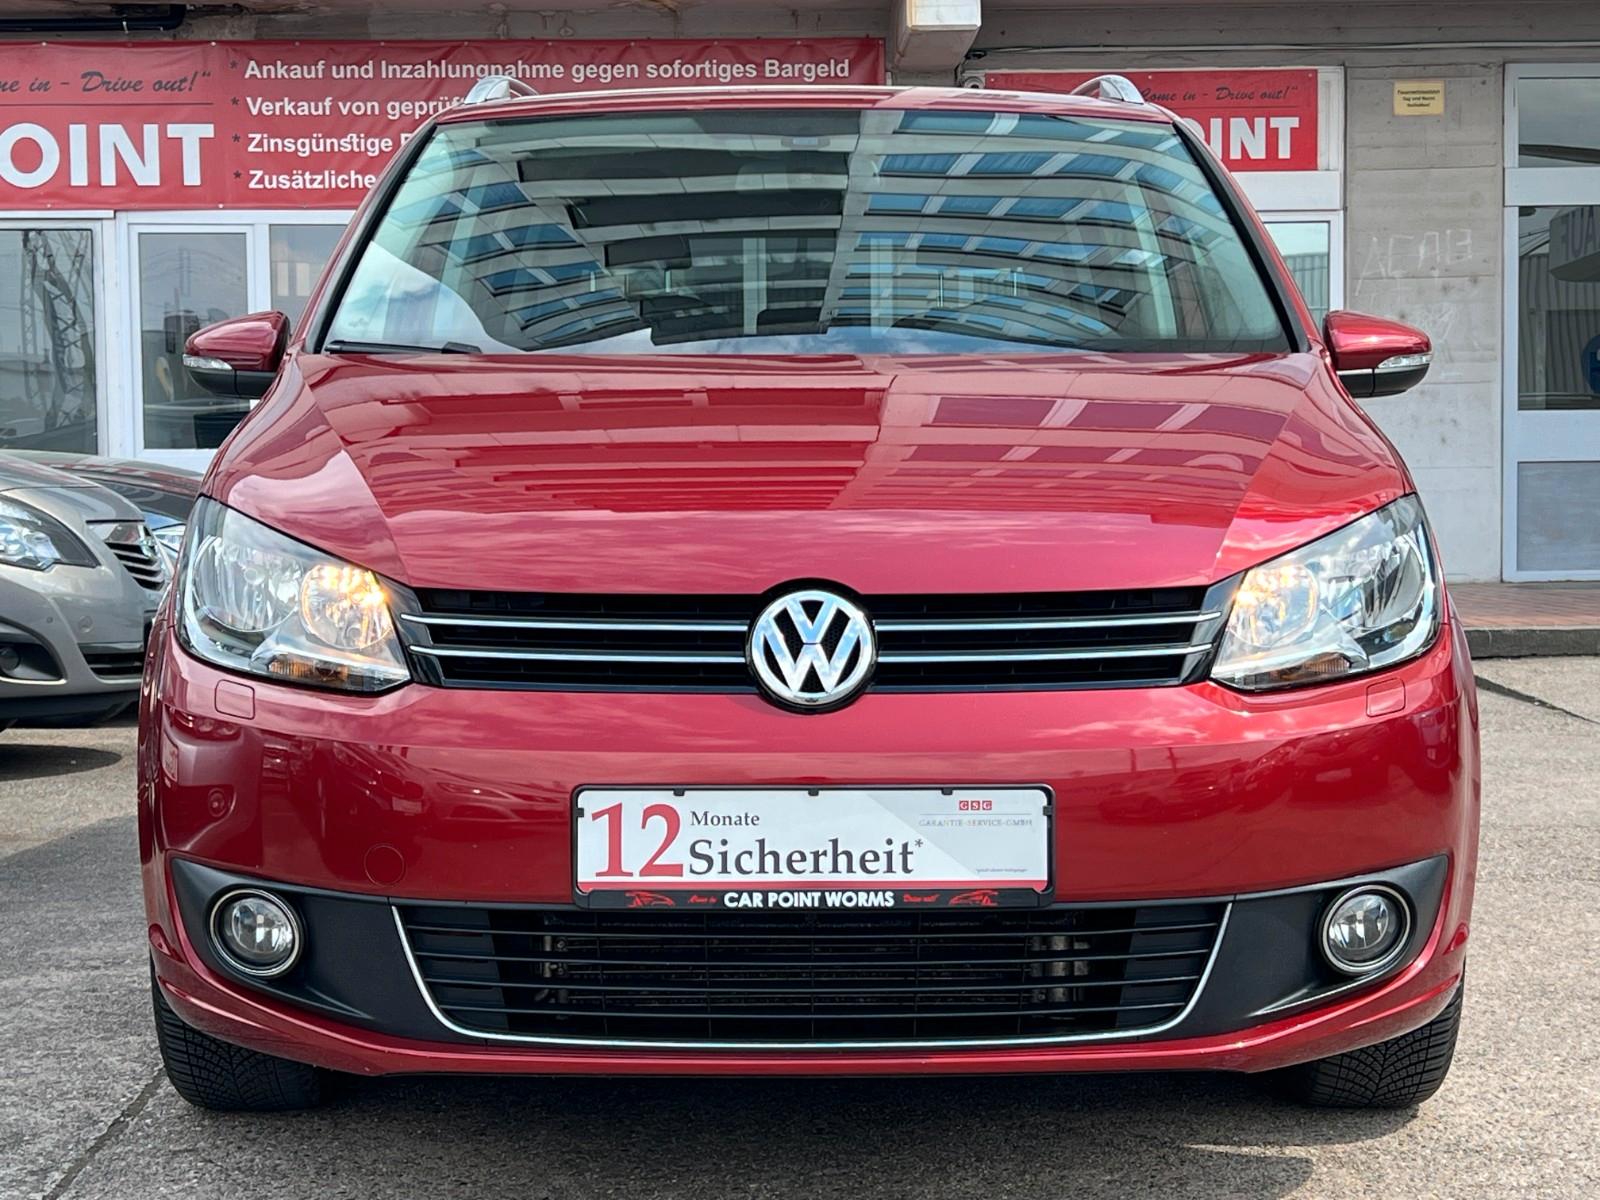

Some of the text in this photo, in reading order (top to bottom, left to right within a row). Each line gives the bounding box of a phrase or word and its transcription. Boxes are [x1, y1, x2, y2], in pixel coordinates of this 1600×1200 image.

[29, 77, 51, 92] in
[80, 71, 143, 92] Drive
[244, 59, 849, 83] Ankauf und Inzahlungnahme gegen sofortiges Bargeld
[1183, 91, 1196, 101] in
[1216, 86, 1254, 101] Drive
[246, 97, 332, 116] Verkauf
[338, 101, 379, 116] von
[247, 132, 393, 157] Zinsgünstige
[248, 169, 377, 190] Zusätzliche
[752, 590, 872, 704] VW
[959, 800, 992, 811] GSG
[690, 810, 760, 827] Monate
[591, 802, 684, 878] 12
[723, 891, 763, 908] CAR
[768, 891, 822, 908] POINT
[825, 890, 895, 908] WORMS
